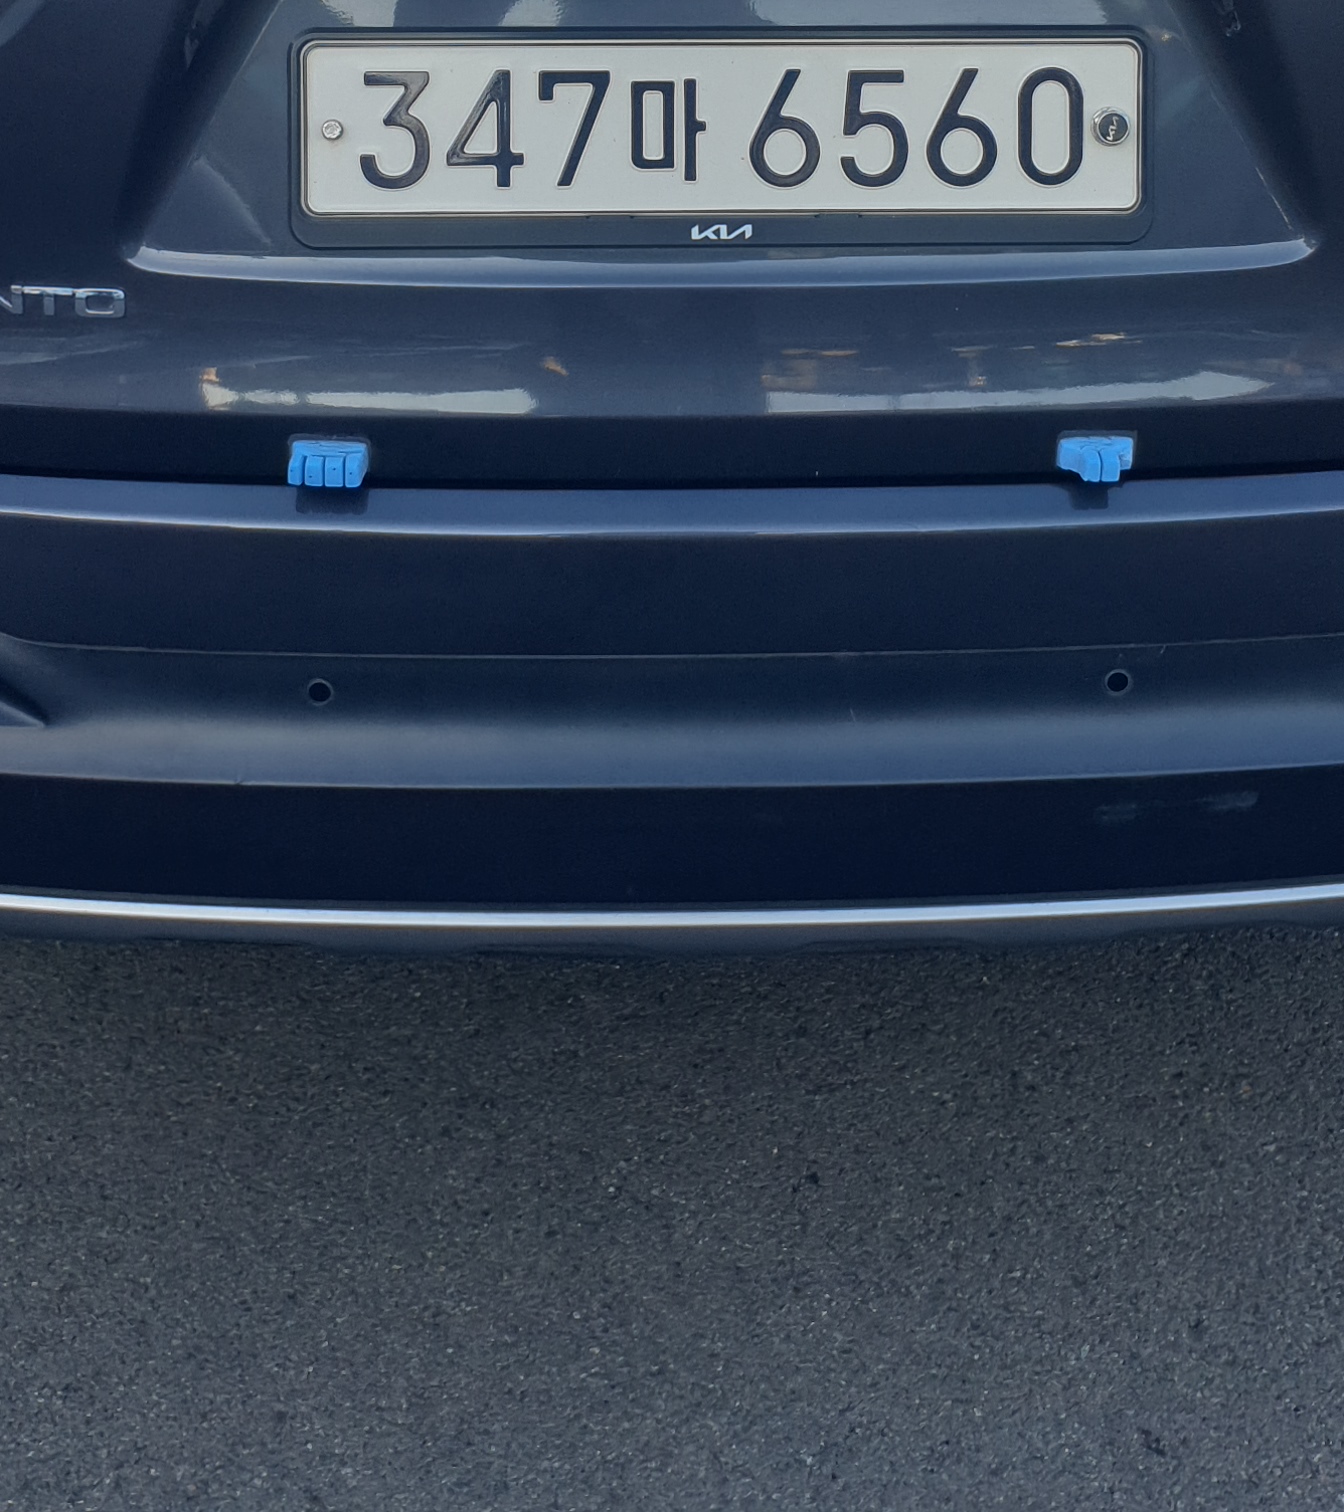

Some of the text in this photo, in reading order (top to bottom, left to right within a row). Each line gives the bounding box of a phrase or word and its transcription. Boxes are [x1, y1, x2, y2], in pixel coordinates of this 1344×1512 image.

[359, 66, 1085, 190] 347마 6560
[690, 223, 754, 241] KIA
